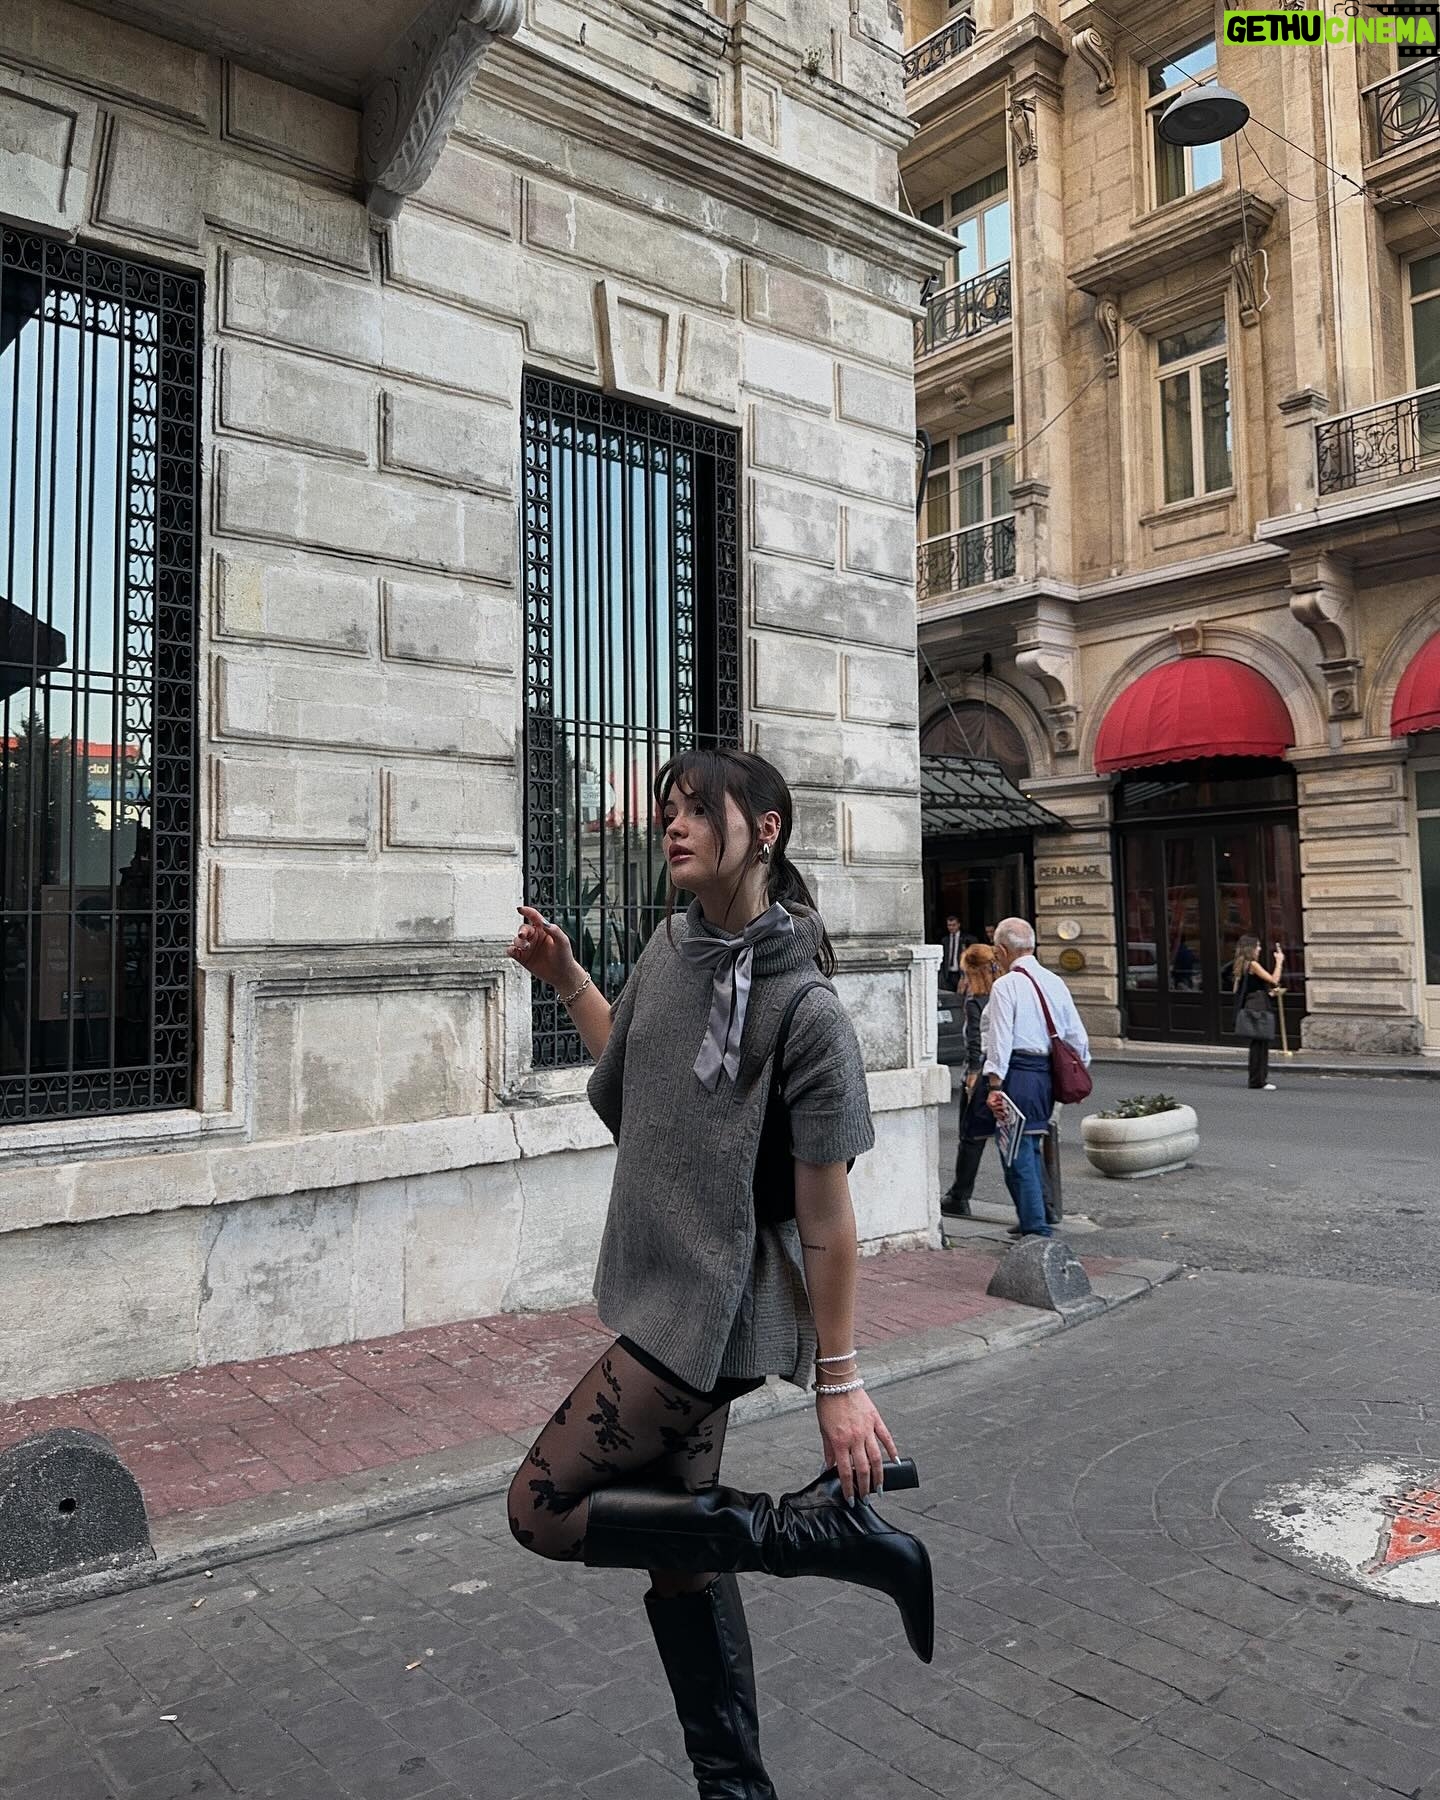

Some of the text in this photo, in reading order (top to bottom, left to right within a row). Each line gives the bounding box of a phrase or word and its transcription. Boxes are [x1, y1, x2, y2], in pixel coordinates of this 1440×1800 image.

[1039, 864, 1101, 877] PERA PALACE
[1054, 895, 1086, 905] HOTEL
